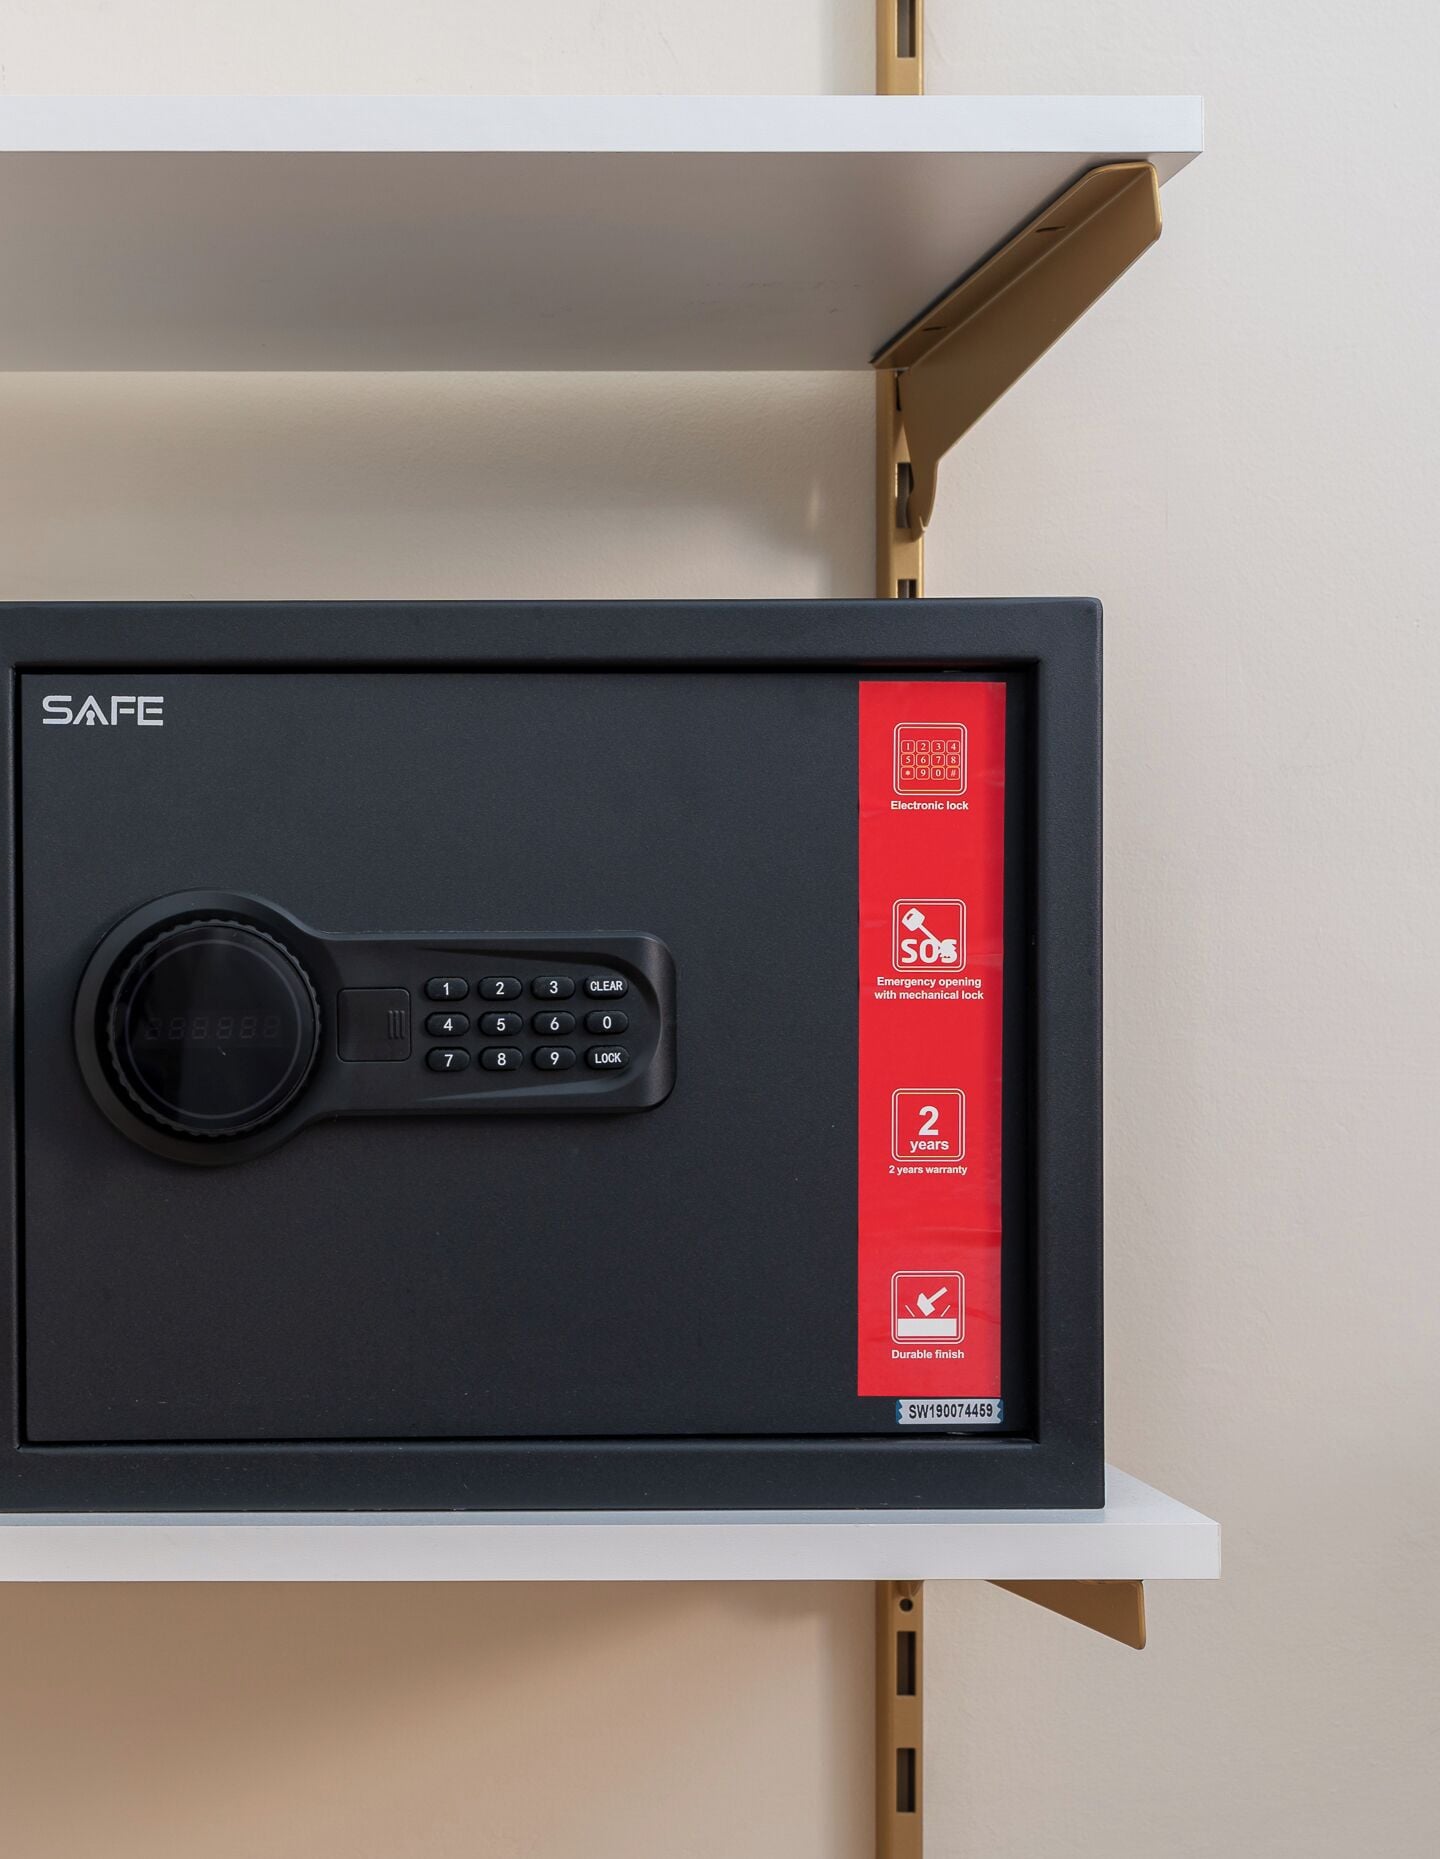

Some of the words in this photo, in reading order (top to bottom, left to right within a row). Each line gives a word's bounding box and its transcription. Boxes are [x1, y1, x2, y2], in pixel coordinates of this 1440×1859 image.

[42, 695, 164, 726] SAFE
[890, 801, 944, 810] Electronic
[946, 801, 969, 810] lock
[443, 982, 449, 996] 1
[495, 981, 505, 995] 2
[549, 980, 558, 994] 3
[589, 980, 623, 992] CLEAR
[876, 976, 936, 988] Emergency
[938, 976, 982, 988] opening
[874, 990, 897, 1000] with
[899, 990, 959, 1000] mechanical
[961, 990, 984, 1000] lock
[443, 1018, 453, 1031] 4
[496, 1018, 506, 1031] 5
[550, 1017, 560, 1030] 6
[603, 1016, 612, 1029] 0
[444, 1054, 454, 1067] 7
[497, 1053, 507, 1066] 8
[550, 1052, 560, 1065] 9
[594, 1052, 622, 1064] LOCK
[918, 1105, 939, 1136] 2
[909, 1140, 950, 1153] years
[888, 1165, 895, 1174] 2
[896, 1166, 924, 1176] years
[925, 1165, 968, 1176] warranty
[891, 1349, 933, 1359] Durable
[935, 1349, 965, 1359] finish
[908, 1403, 993, 1419] SW190074459
